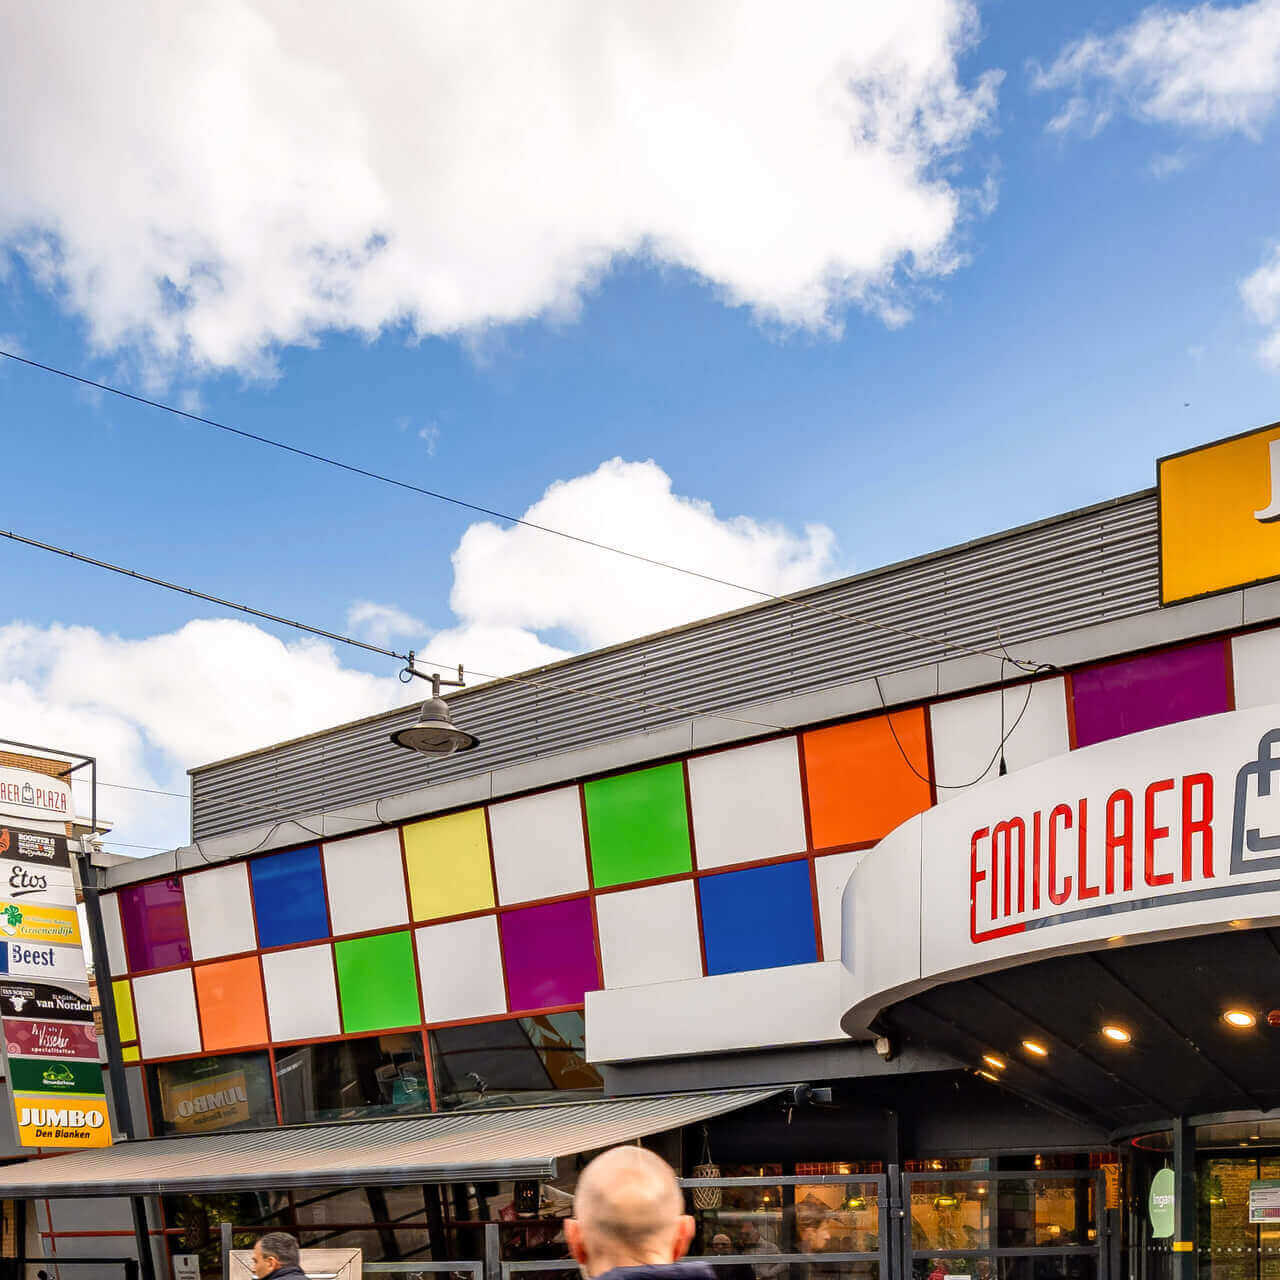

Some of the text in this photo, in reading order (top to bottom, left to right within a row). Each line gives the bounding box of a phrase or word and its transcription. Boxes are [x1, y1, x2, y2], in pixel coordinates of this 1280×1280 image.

[36, 788, 67, 811] PLAZA
[969, 771, 1216, 944] EMICLAER
[9, 865, 47, 889] Etos
[12, 944, 56, 967] Beest
[36, 999, 93, 1012] van Norden
[19, 1107, 105, 1129] JUMBO
[35, 1128, 91, 1139] Den Blanken
